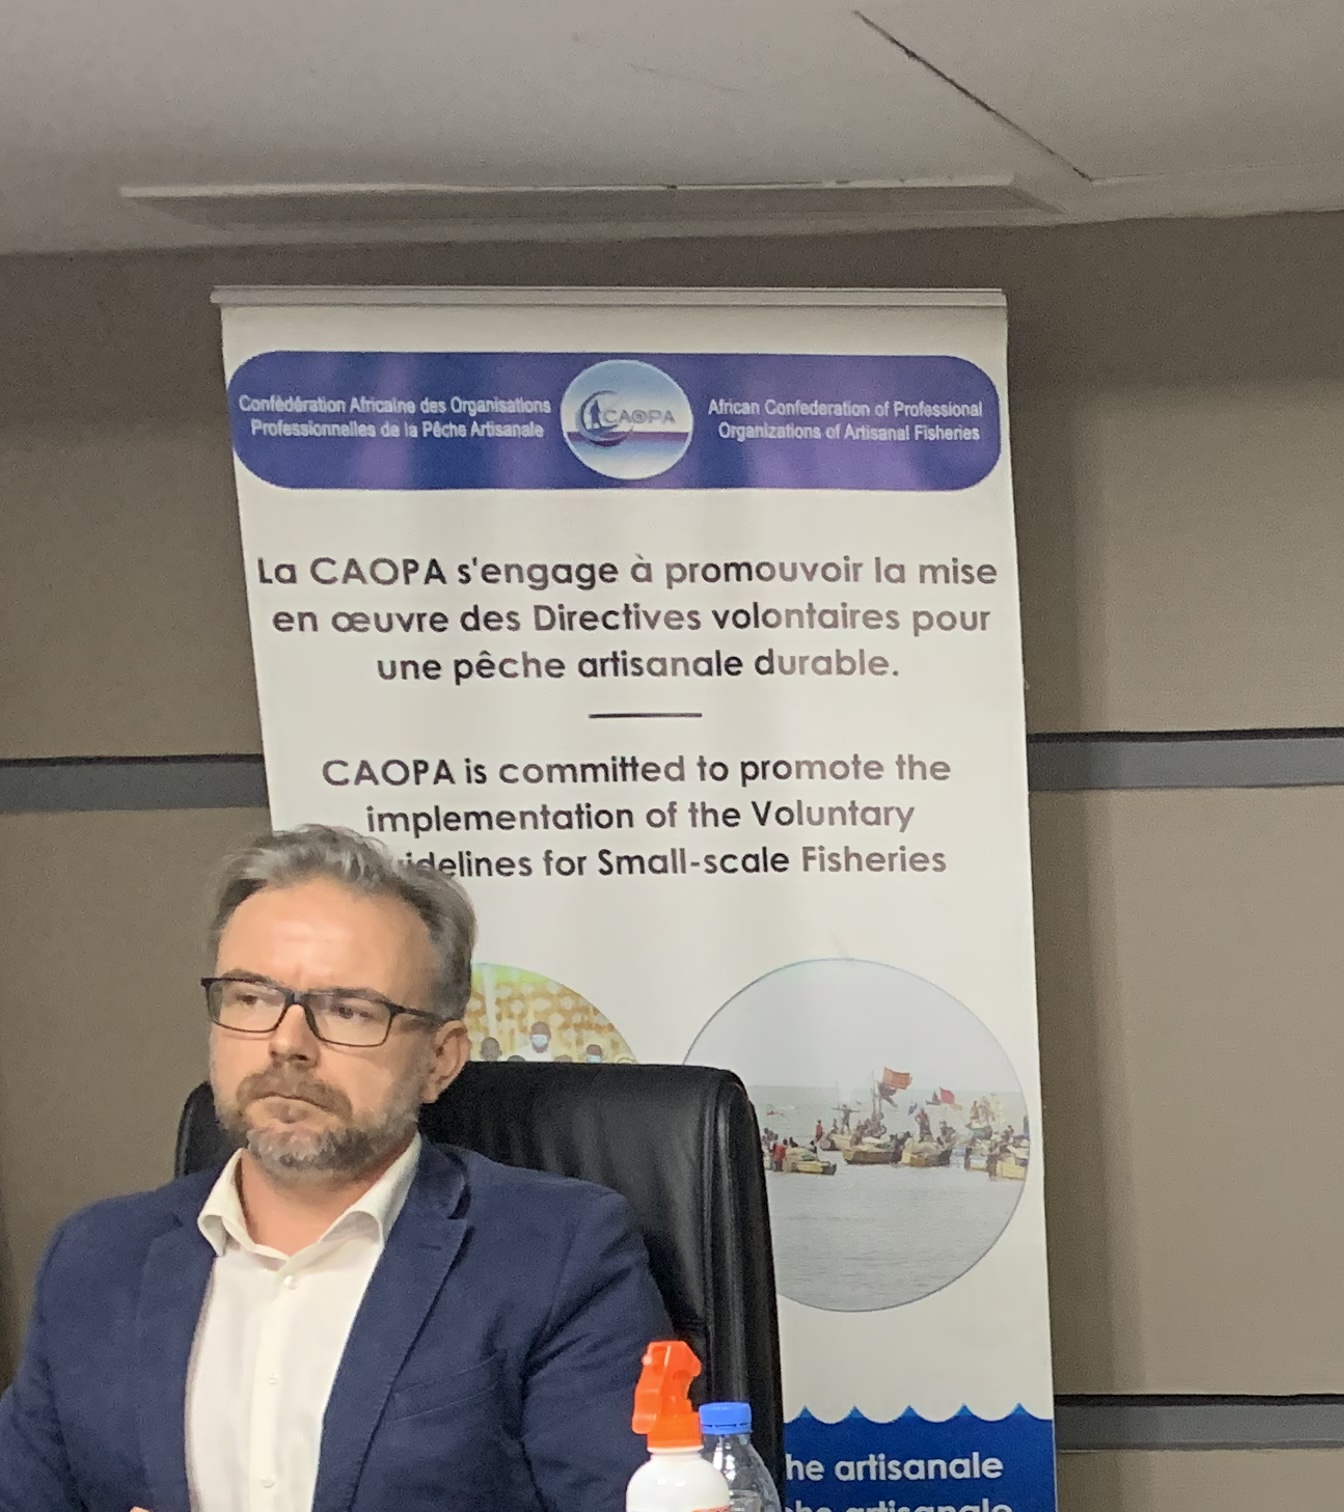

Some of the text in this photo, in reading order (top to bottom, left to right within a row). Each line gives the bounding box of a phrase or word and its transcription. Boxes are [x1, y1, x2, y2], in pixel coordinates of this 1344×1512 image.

[239, 395, 551, 416] Confédération Africaine des Organisations
[604, 408, 675, 424] CAOPA
[708, 399, 982, 417] African Confederation of Professional
[251, 419, 544, 438] Professionnelles de la Pêche Artisanale
[719, 422, 980, 442] Organizations of Artisanal Fisheries
[258, 557, 297, 584] La
[310, 557, 447, 586] CAOPA
[631, 554, 652, 582] à
[666, 555, 863, 589] promouvoir
[875, 556, 905, 584] la
[920, 557, 997, 585] mise
[273, 611, 318, 632] en
[460, 604, 520, 631] des
[534, 602, 701, 631] Directives
[712, 601, 899, 630] volontaires
[913, 611, 990, 637] pour
[378, 648, 898, 686] une pêche artisanale durable.
[323, 753, 950, 788] CAOPA is committed to promote the
[366, 799, 914, 839] implementation of the Voluntary
[543, 845, 946, 876] for Small-scale Fisheries
[835, 1451, 1003, 1481] artisanale
